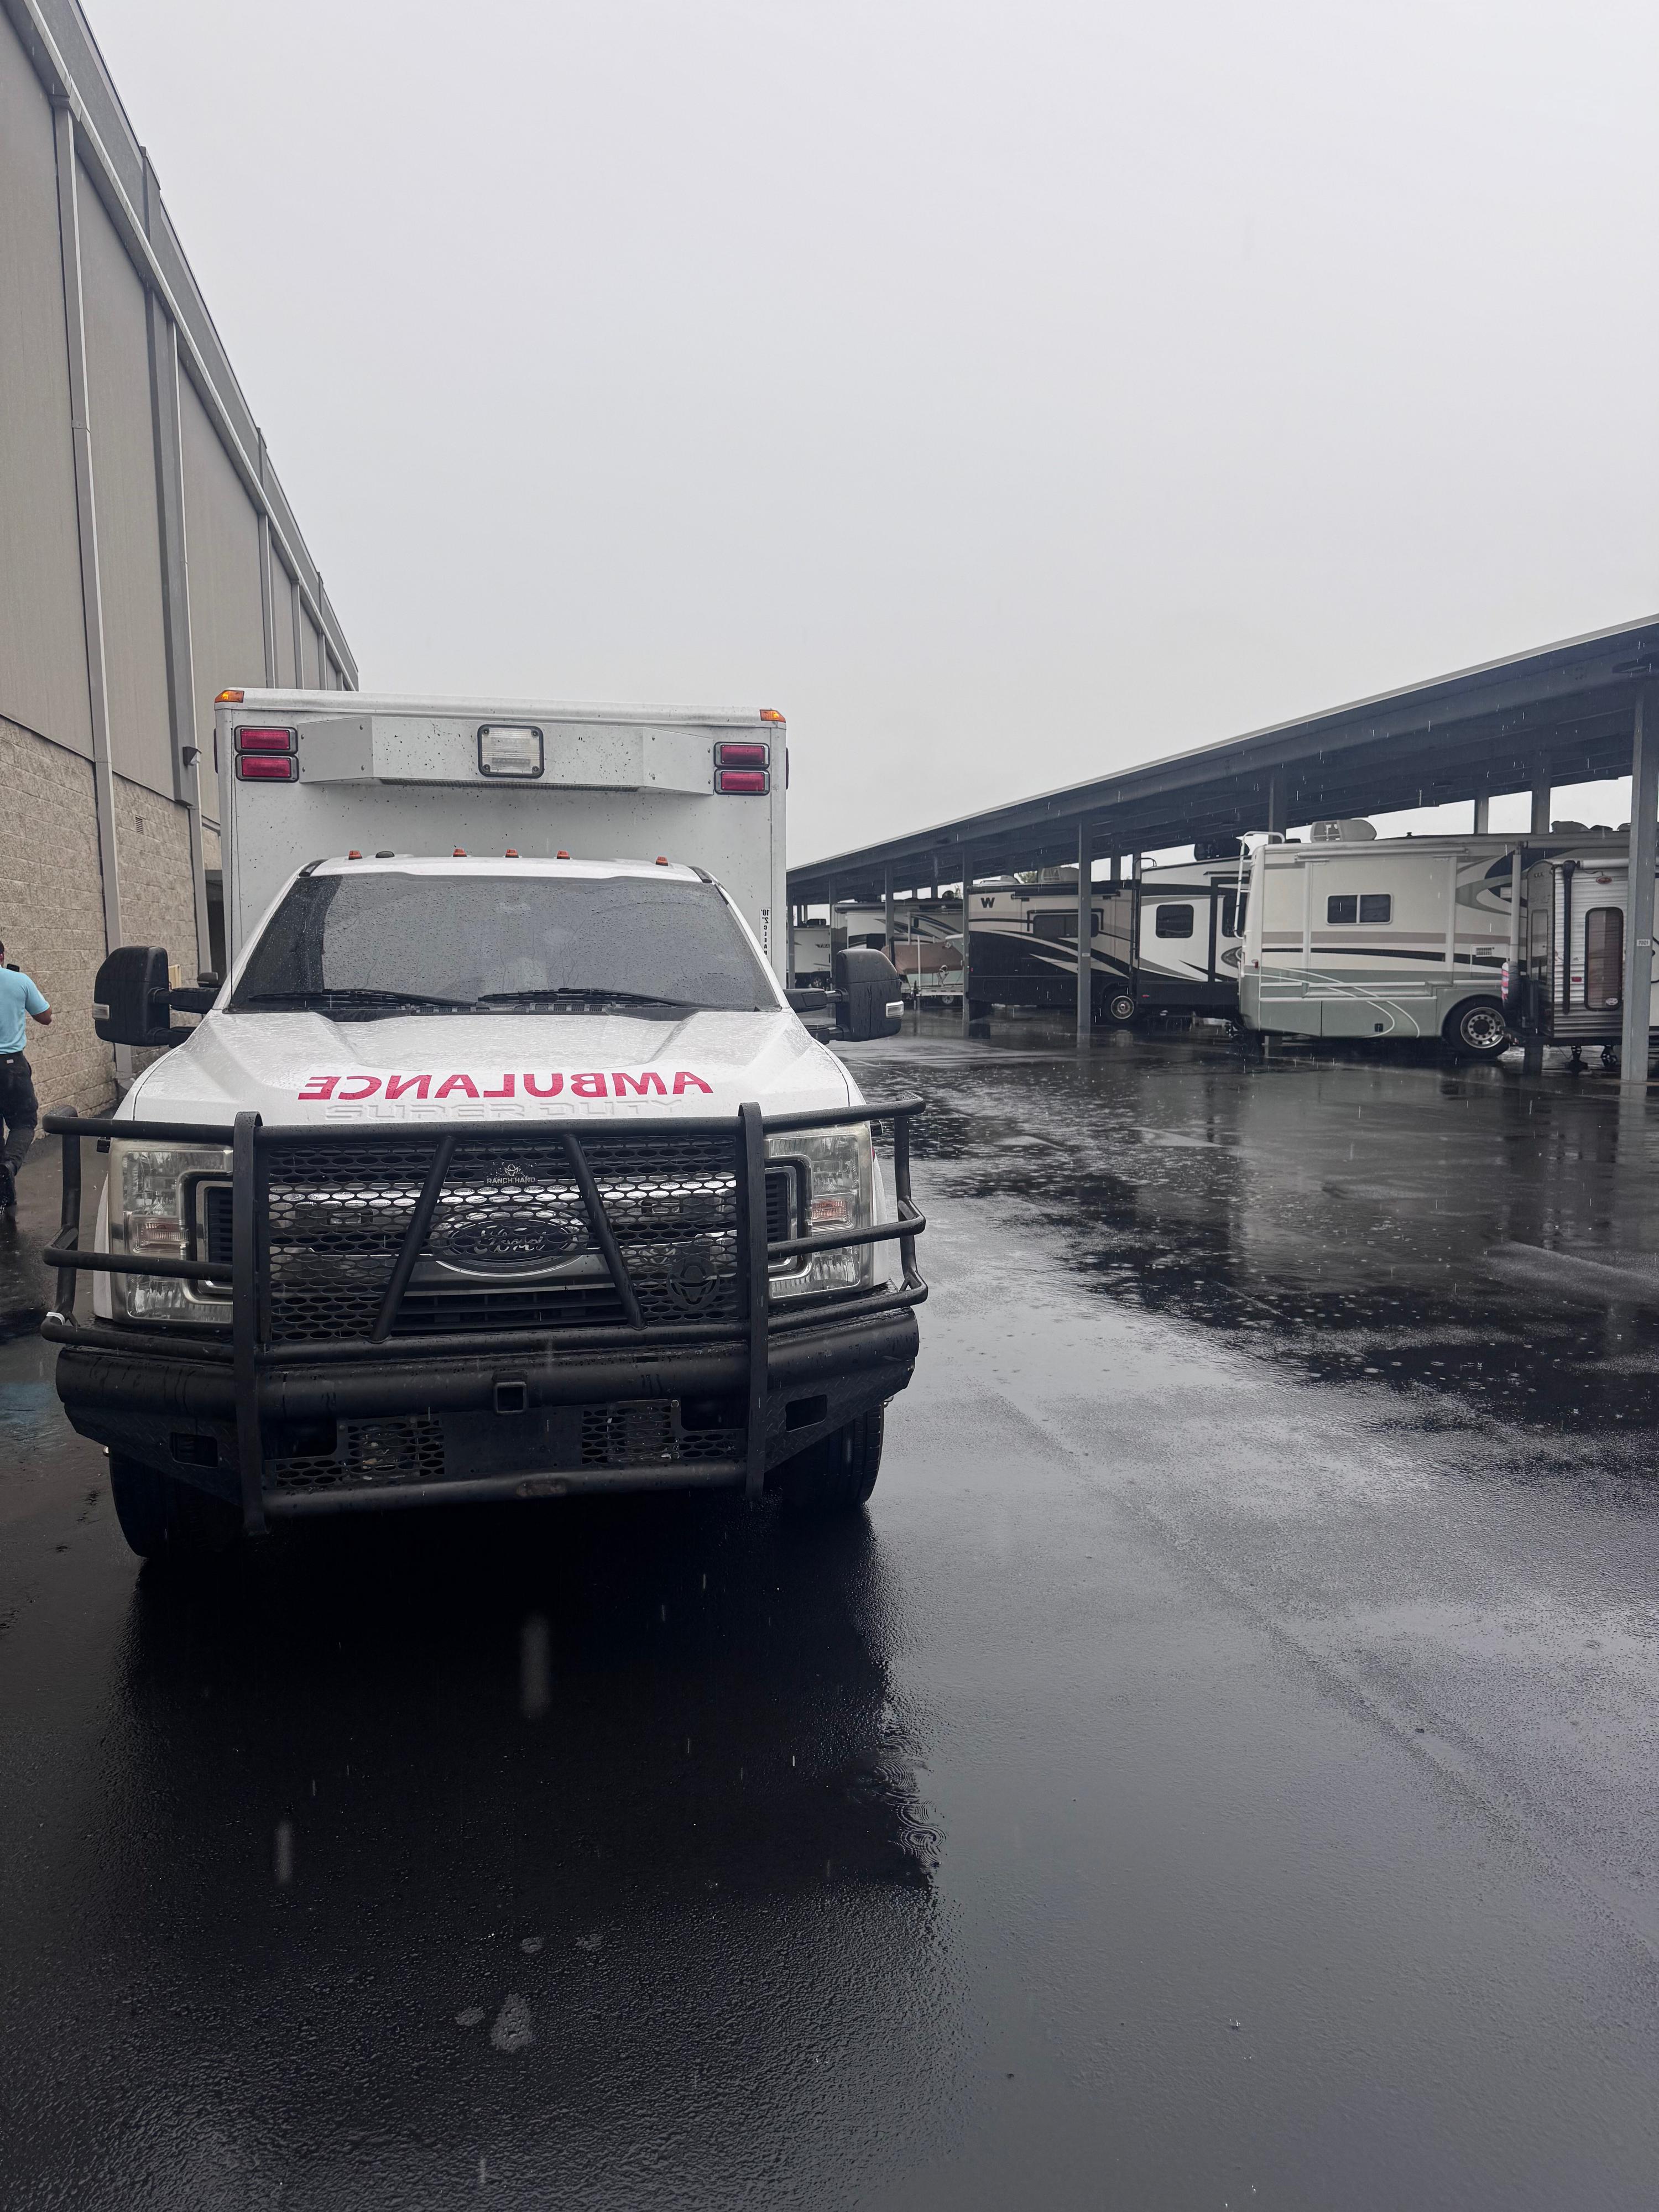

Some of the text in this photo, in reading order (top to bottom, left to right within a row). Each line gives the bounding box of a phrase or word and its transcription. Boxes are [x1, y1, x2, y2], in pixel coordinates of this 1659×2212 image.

[980, 897, 995, 908] W
[324, 1099, 683, 1121] SUPER DUTY
